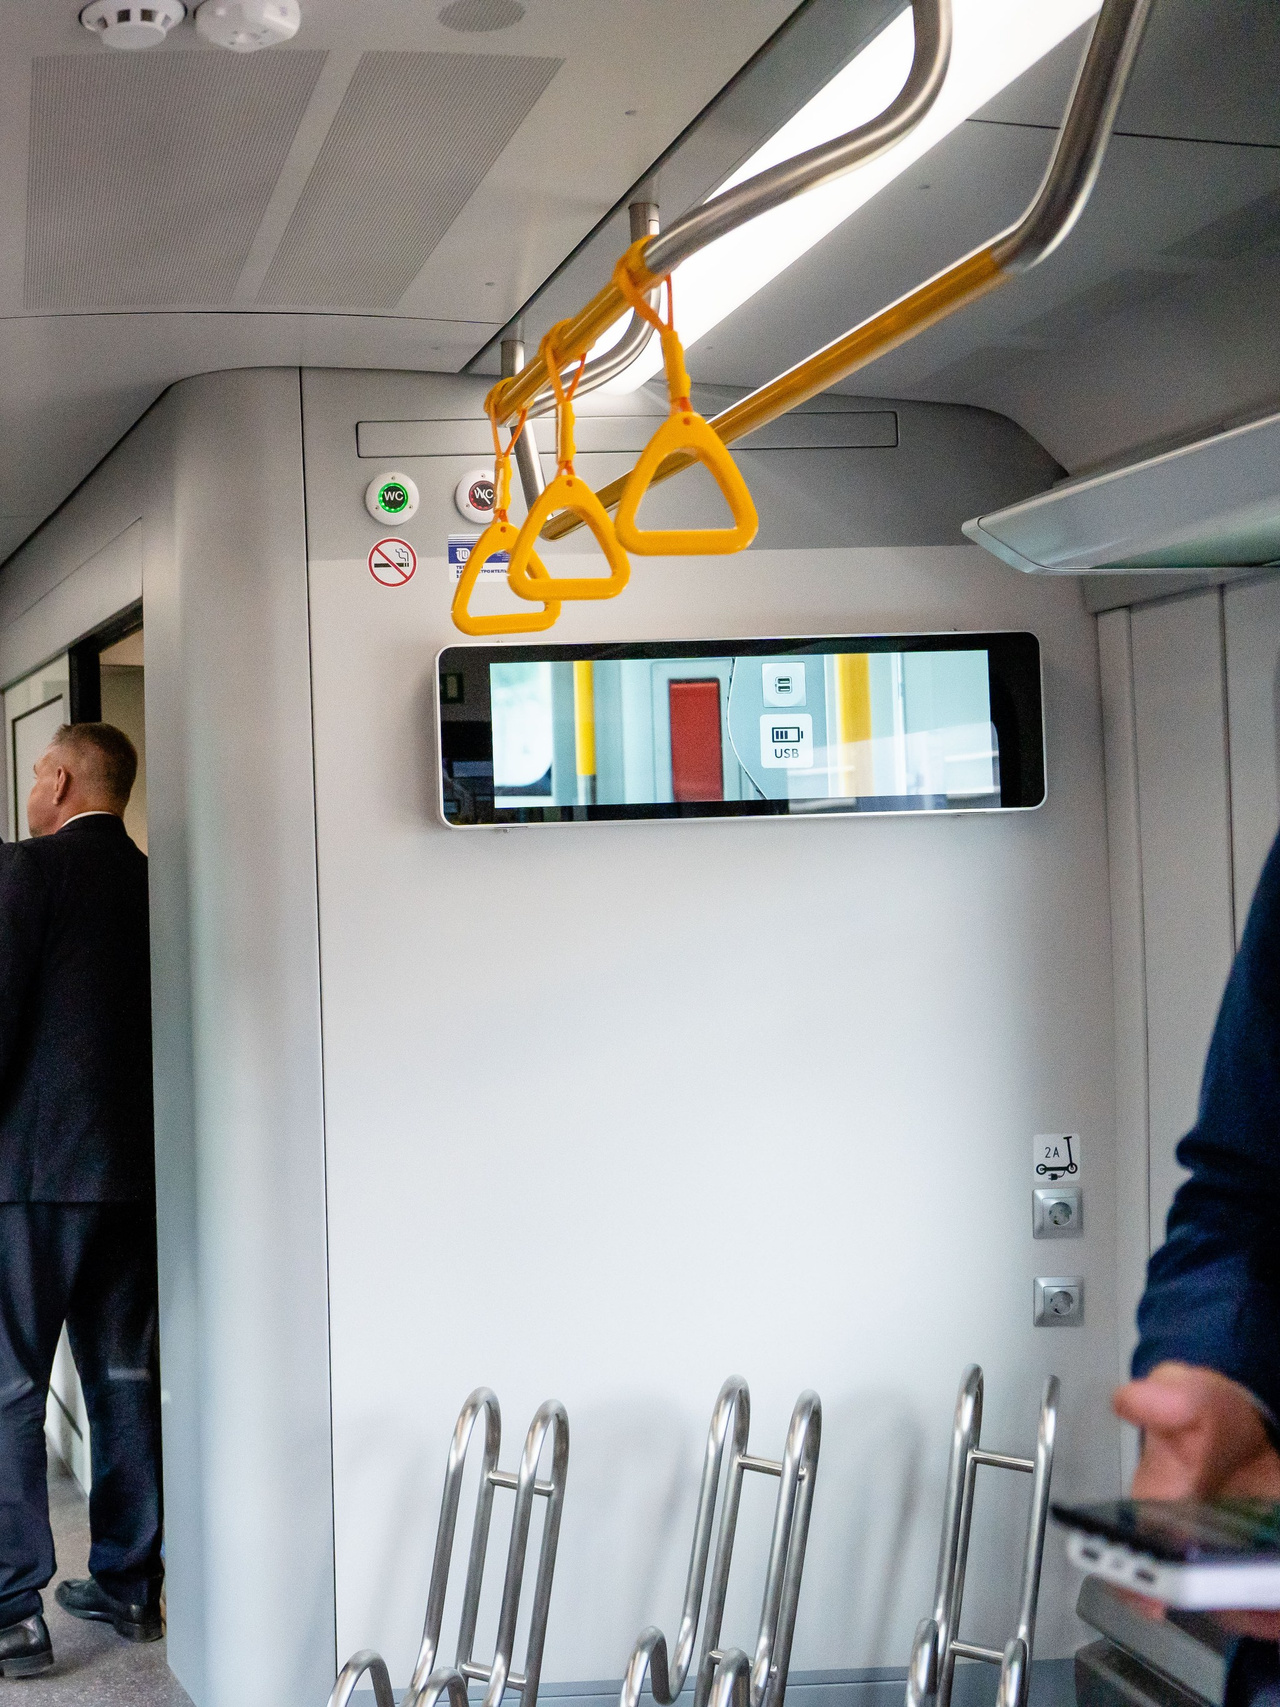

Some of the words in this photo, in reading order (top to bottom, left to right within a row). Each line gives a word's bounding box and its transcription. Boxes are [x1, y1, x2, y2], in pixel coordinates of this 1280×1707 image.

[384, 491, 404, 501] WC
[474, 489, 494, 499] WC
[774, 748, 799, 759] USB
